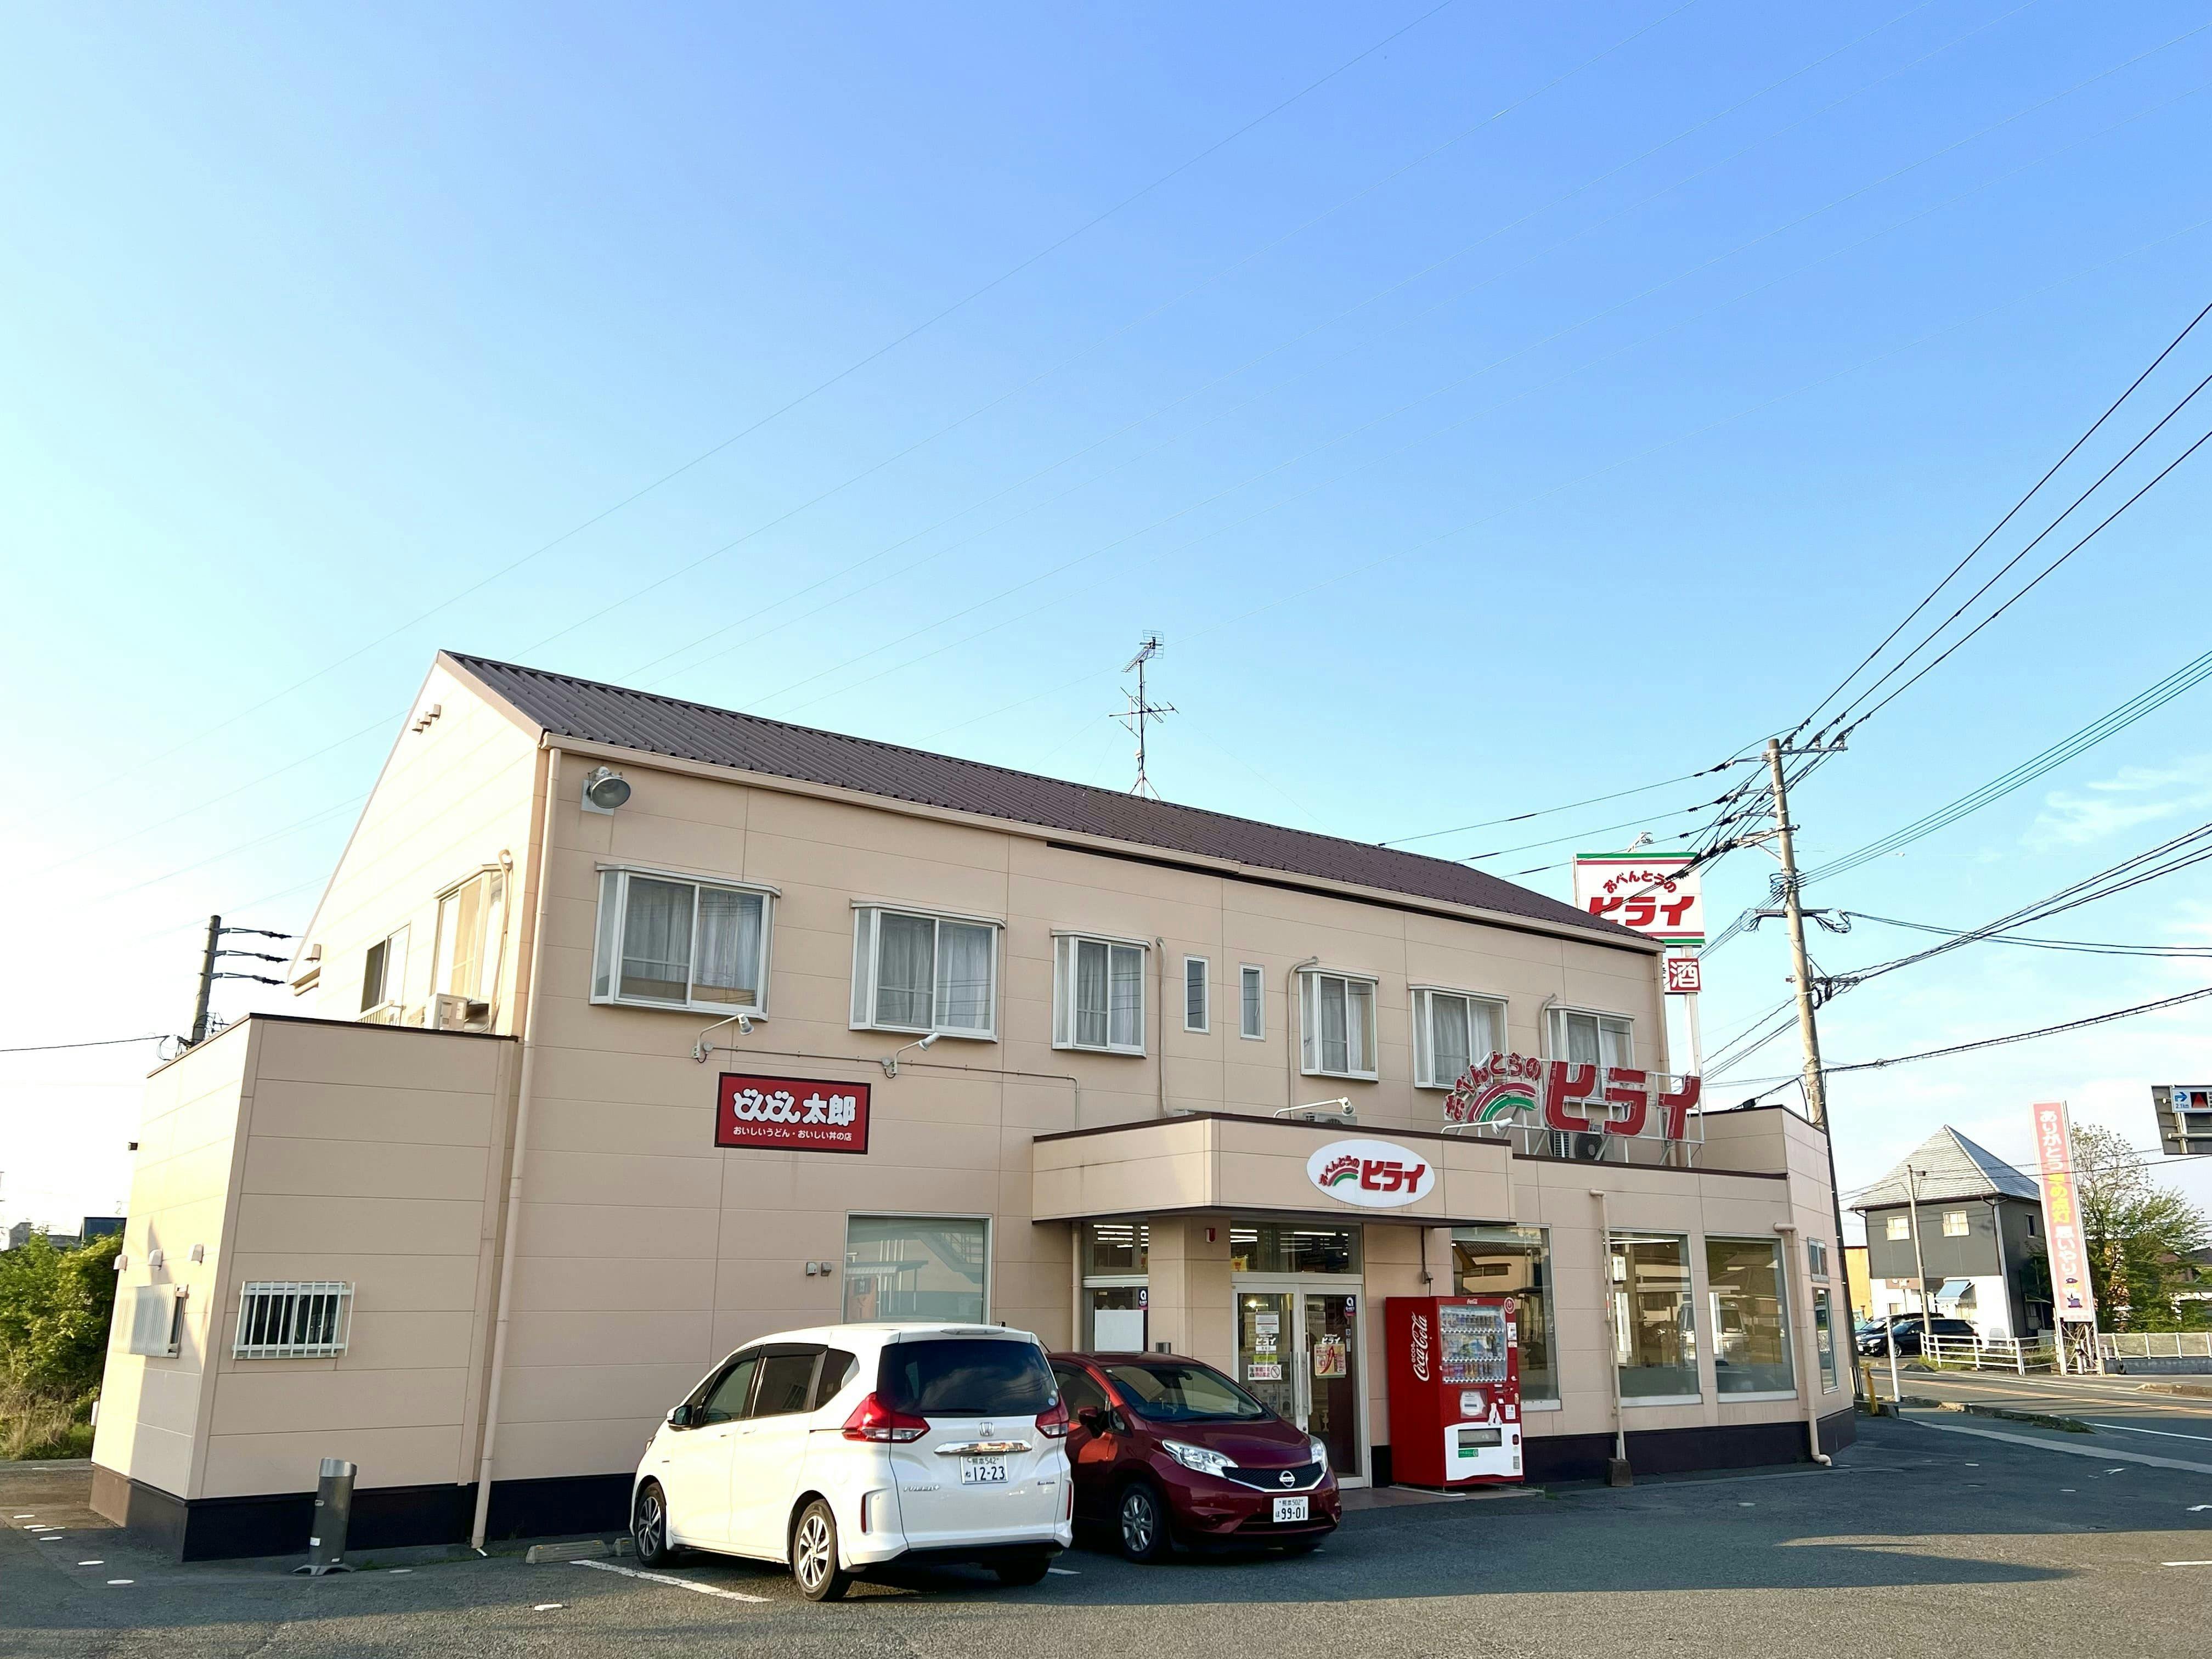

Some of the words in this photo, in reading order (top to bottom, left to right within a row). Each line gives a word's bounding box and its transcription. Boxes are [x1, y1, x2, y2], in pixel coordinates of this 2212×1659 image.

[1603, 871, 1677, 893] おべんとうの
[1589, 896, 1695, 926] ヒライ
[1670, 961, 1699, 988] 酒
[1445, 1050, 1542, 1122] おべんとうの
[1544, 1060, 1701, 1140] ヒライ
[733, 1088, 856, 1126] どんどん太郎
[2040, 1110, 2063, 1171] ありがとう
[1360, 1160, 1426, 1193] ヒライ
[1412, 1311, 1429, 1381] Coca-Cola
[1281, 1507, 1305, 1520] 99-01
